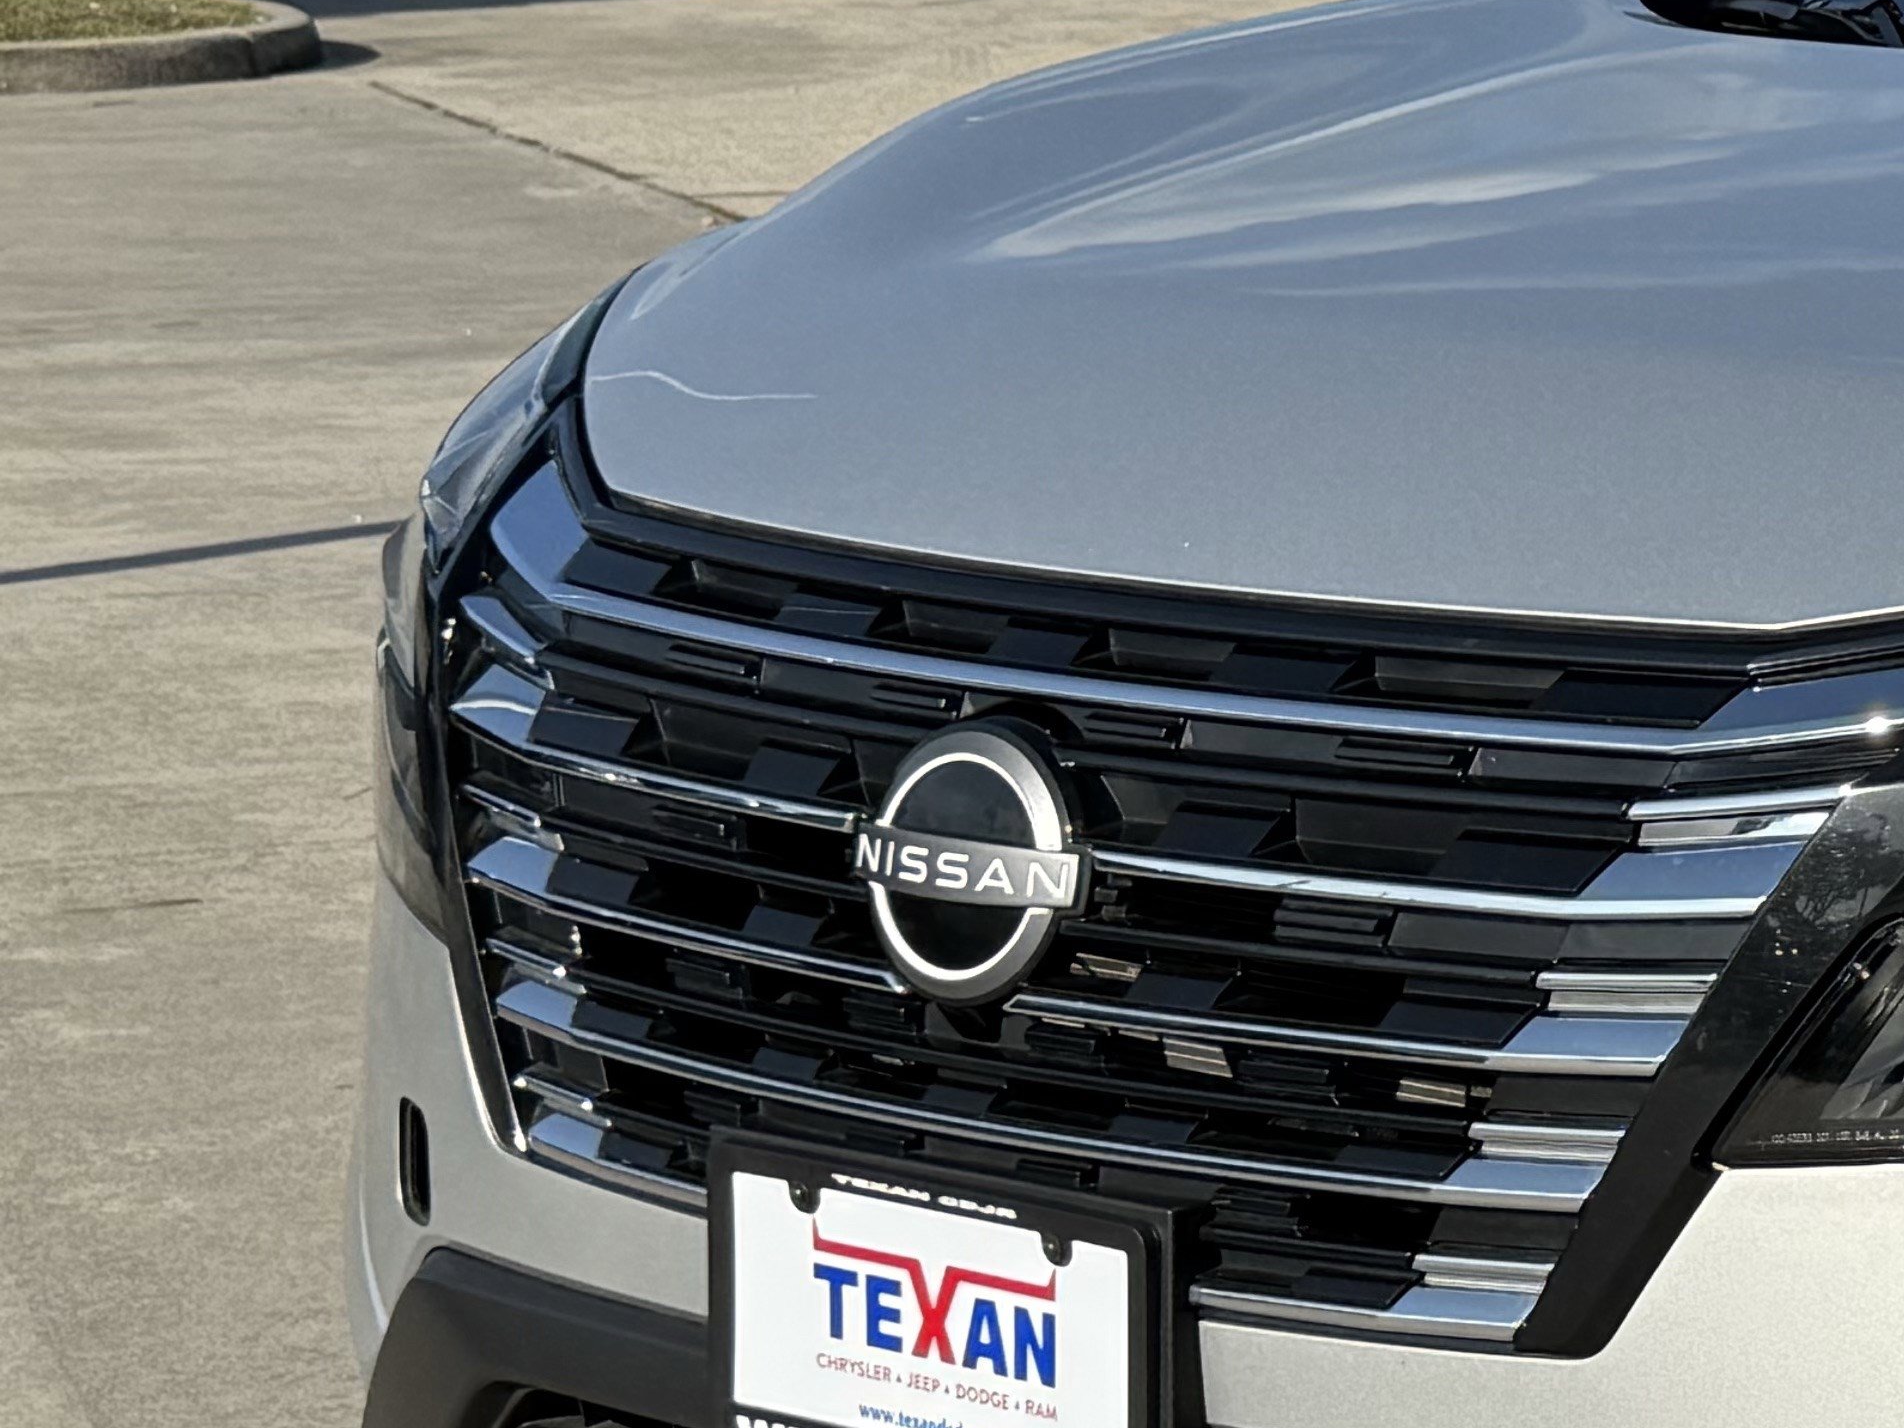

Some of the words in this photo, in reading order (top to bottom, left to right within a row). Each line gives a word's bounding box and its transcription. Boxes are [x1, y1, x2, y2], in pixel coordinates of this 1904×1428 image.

[855, 833, 1070, 898] NISSAN
[812, 1217, 1057, 1389] TEXAN
[816, 1352, 892, 1382] CHRYSLER
[906, 1373, 941, 1394] JEEP
[955, 1384, 1010, 1411] DODGE
[1025, 1399, 1058, 1421] RAM
